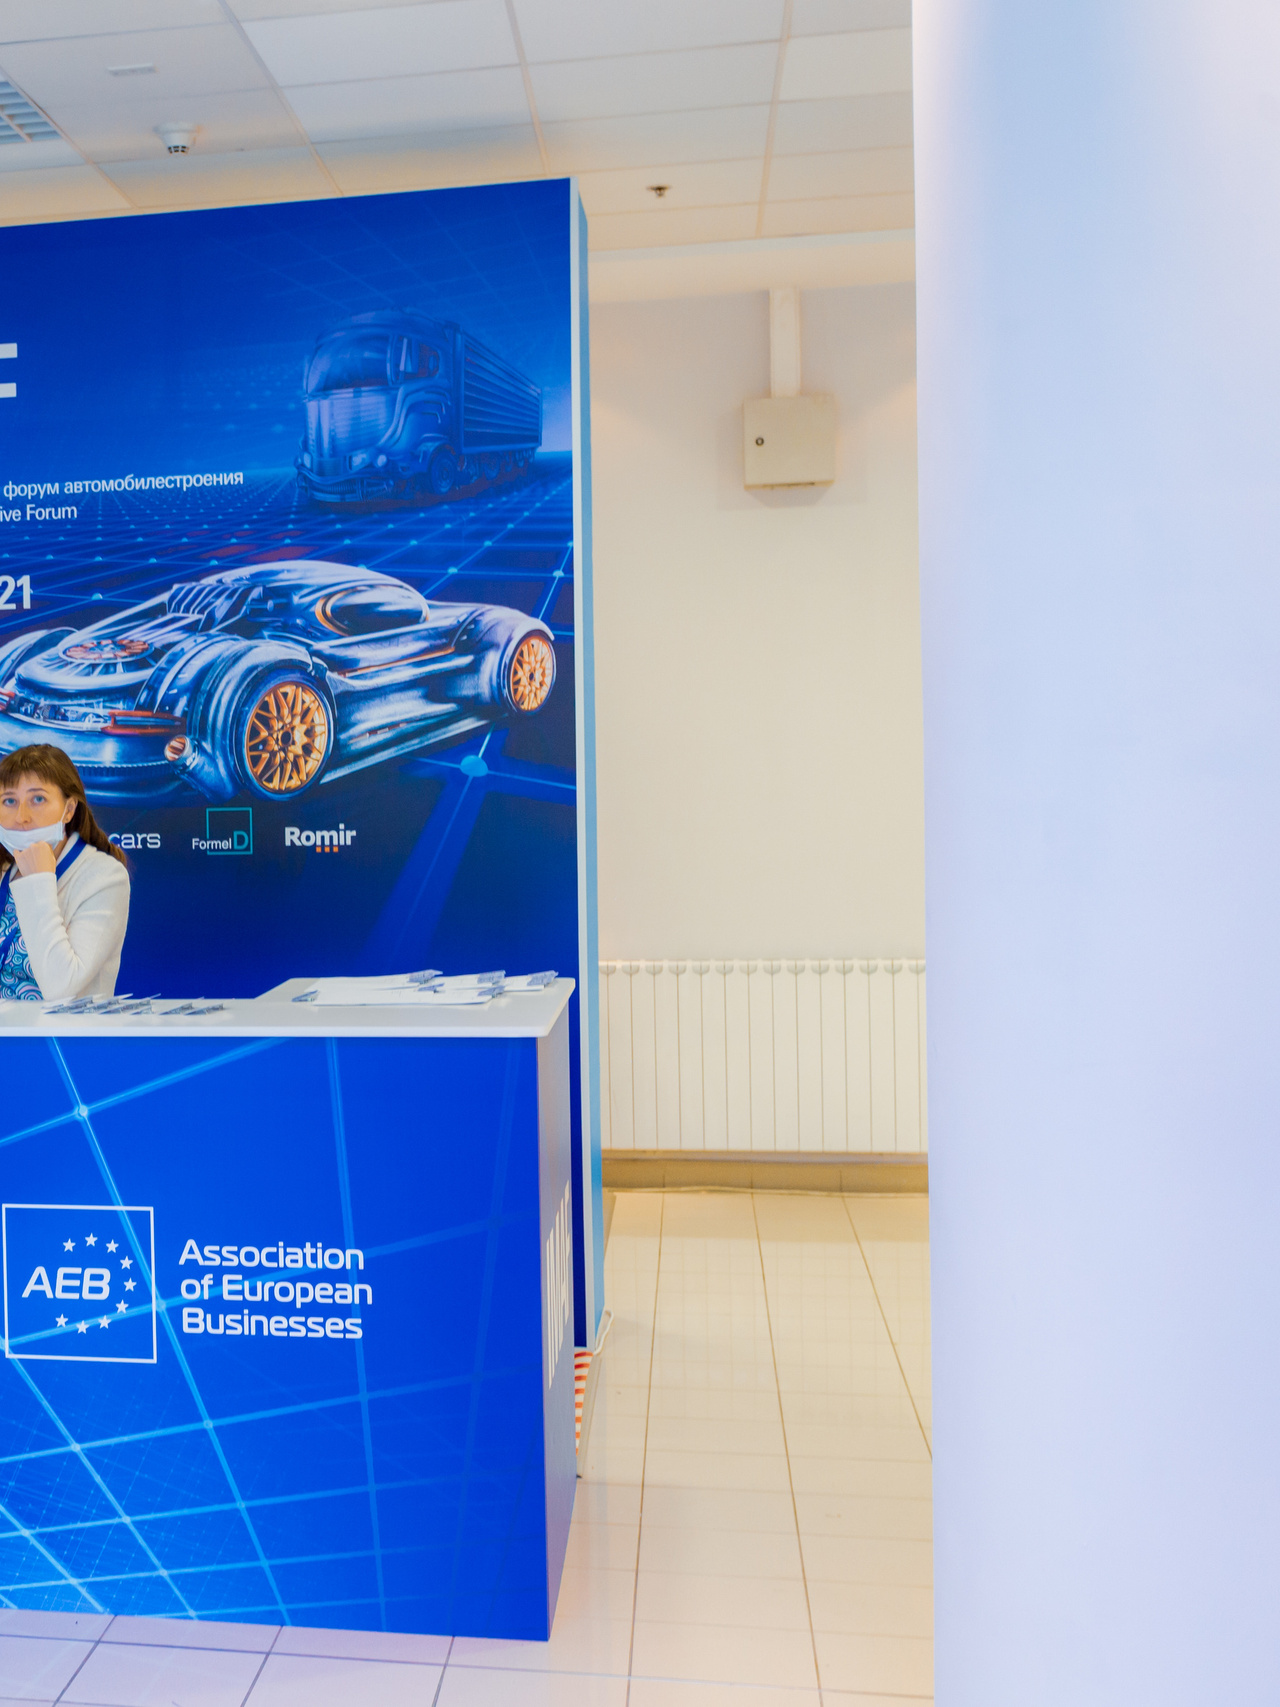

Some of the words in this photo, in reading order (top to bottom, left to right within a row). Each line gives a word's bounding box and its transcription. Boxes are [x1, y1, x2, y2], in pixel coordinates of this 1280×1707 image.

[3, 480, 60, 501] форум
[64, 471, 244, 494] автомобилестроения
[26, 504, 78, 522] Forum
[284, 823, 357, 847] Romir
[178, 1239, 364, 1271] Association
[21, 1266, 111, 1300] AEB
[180, 1274, 213, 1300] of
[221, 1274, 372, 1308] European
[182, 1307, 363, 1339] Businesses
